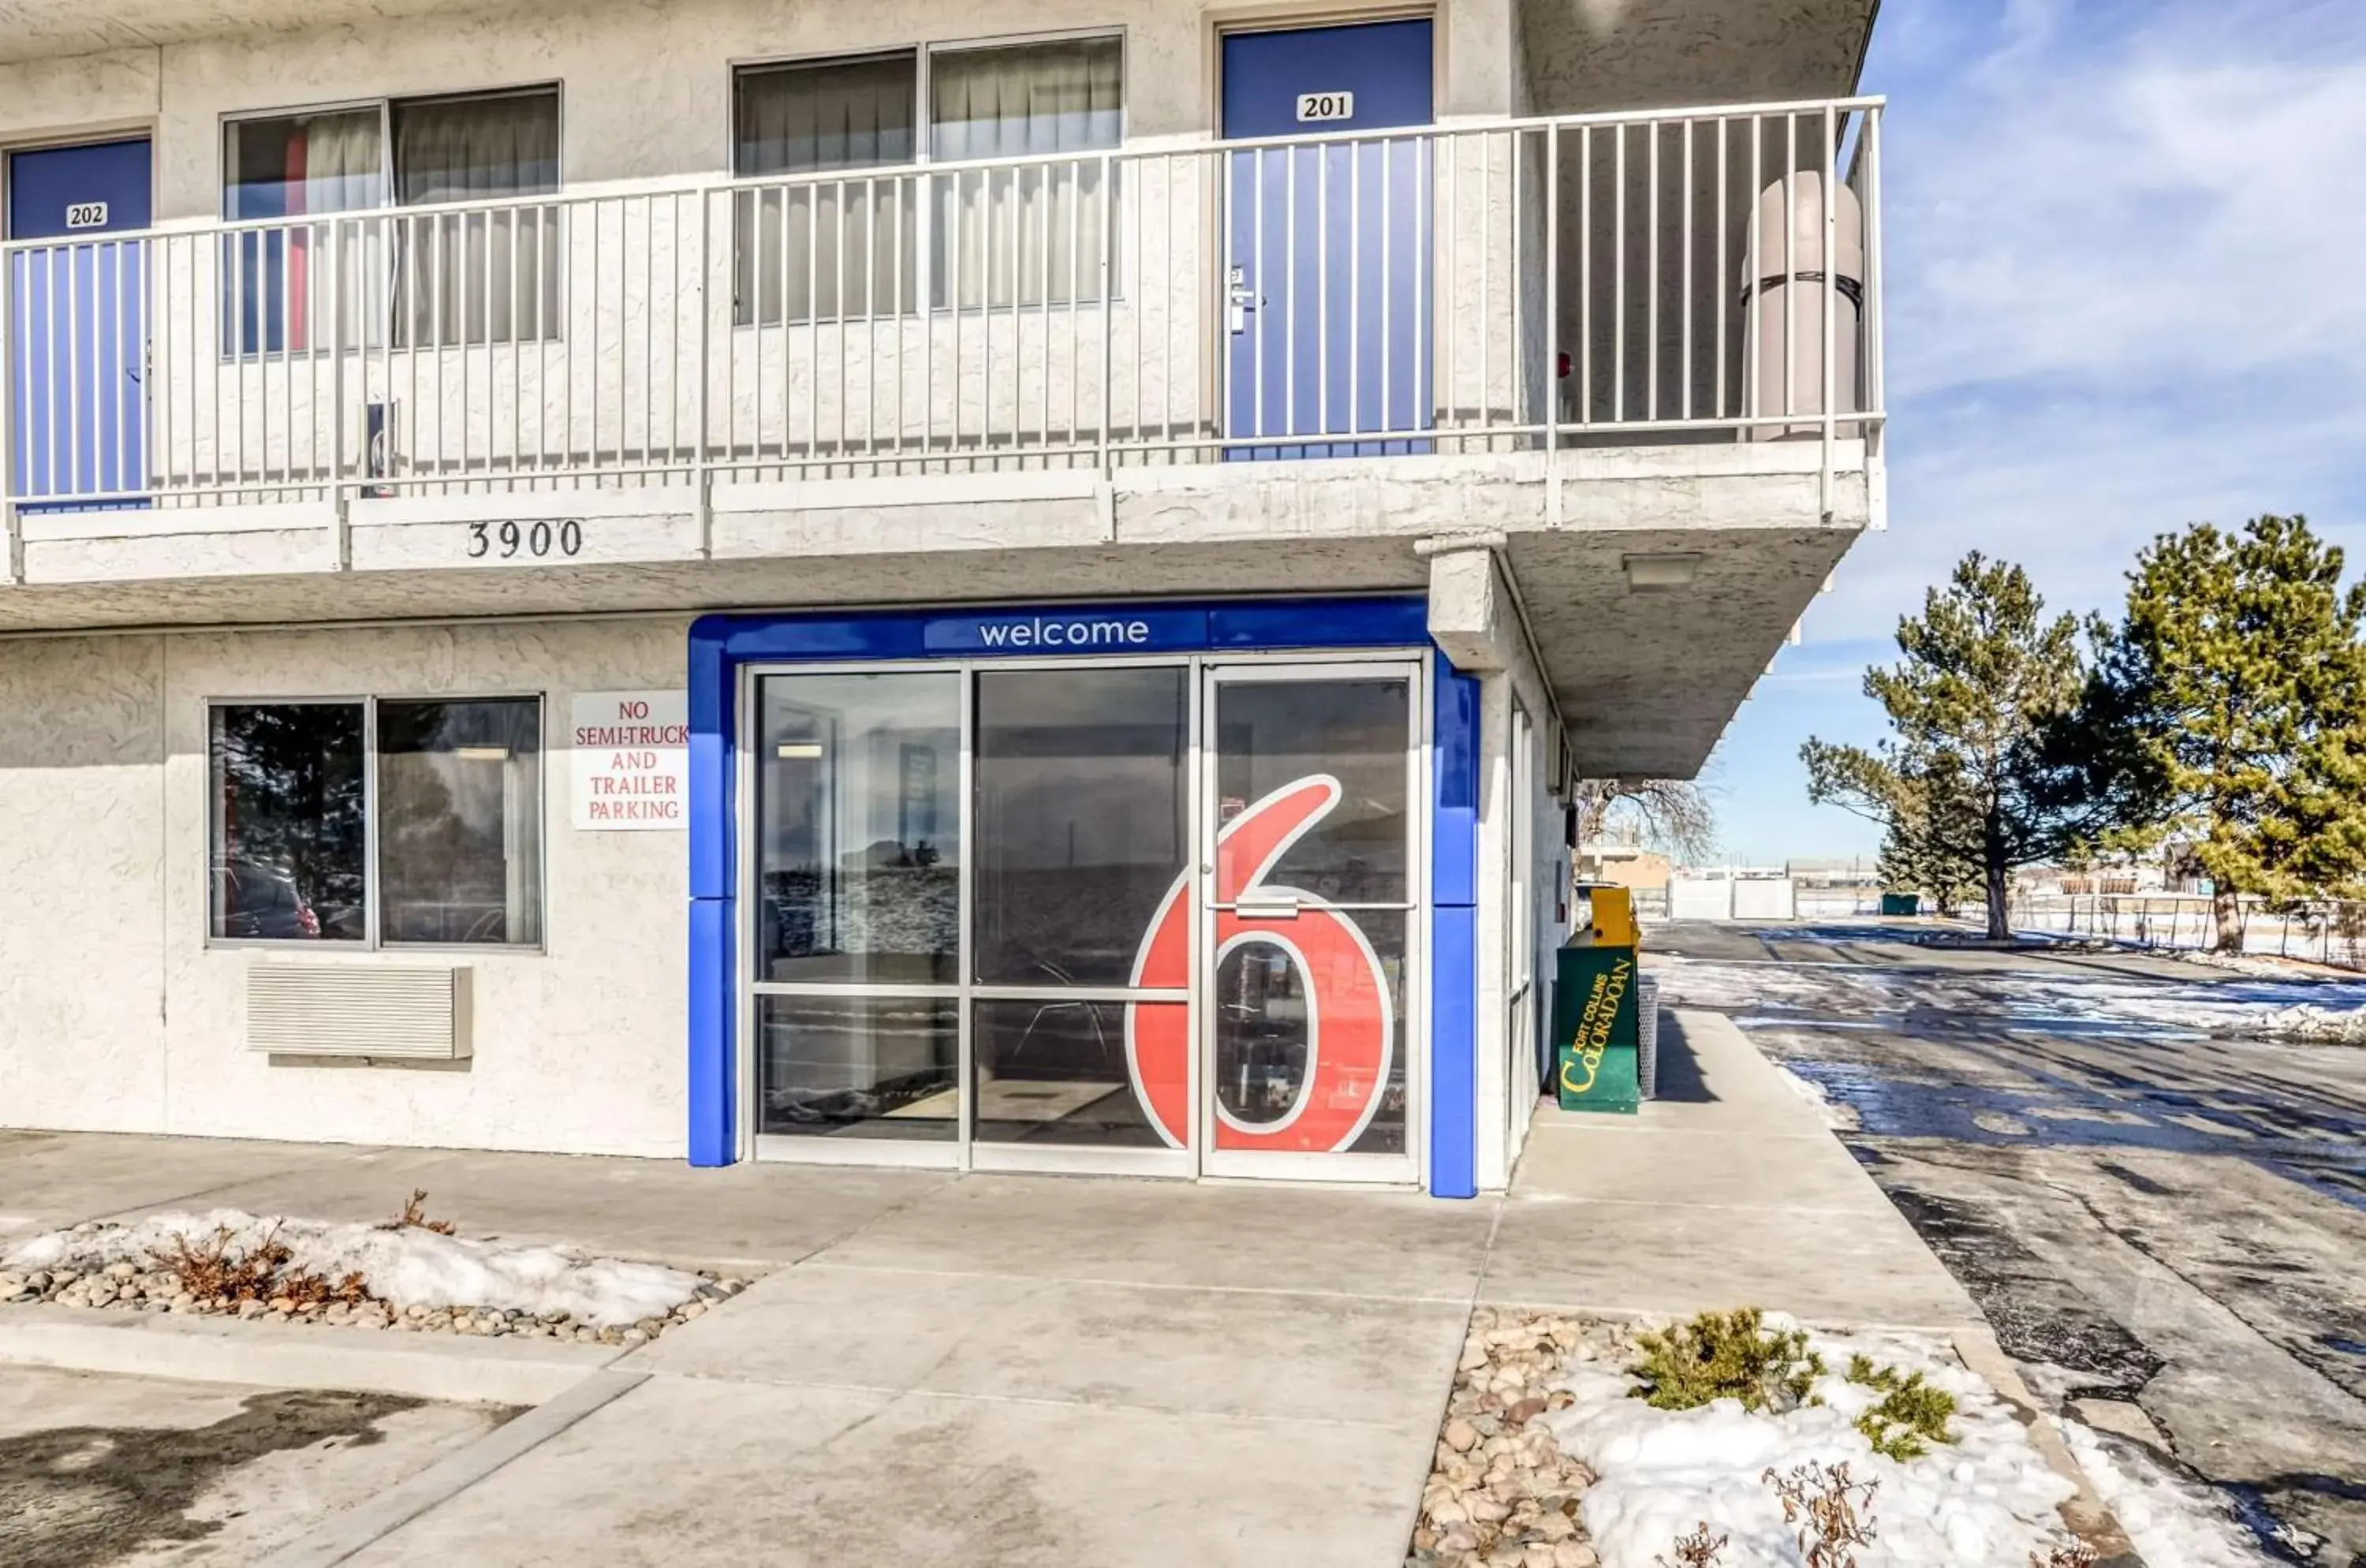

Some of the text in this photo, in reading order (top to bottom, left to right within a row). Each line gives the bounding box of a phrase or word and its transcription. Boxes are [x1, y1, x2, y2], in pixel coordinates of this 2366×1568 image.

[1304, 96, 1345, 118] 201
[71, 206, 103, 225] 202
[468, 520, 581, 558] 3900
[980, 618, 1149, 646] welcome
[619, 701, 649, 719] NO
[576, 726, 689, 745] SEMI-TRUCK
[611, 752, 657, 770] AND
[590, 775, 677, 795] TRAILER
[589, 801, 678, 819] PARKING
[1125, 774, 1394, 1152] 6
[1561, 957, 1631, 1092] COLORADOAN
[1573, 973, 1609, 1055] FORT COLLINS
